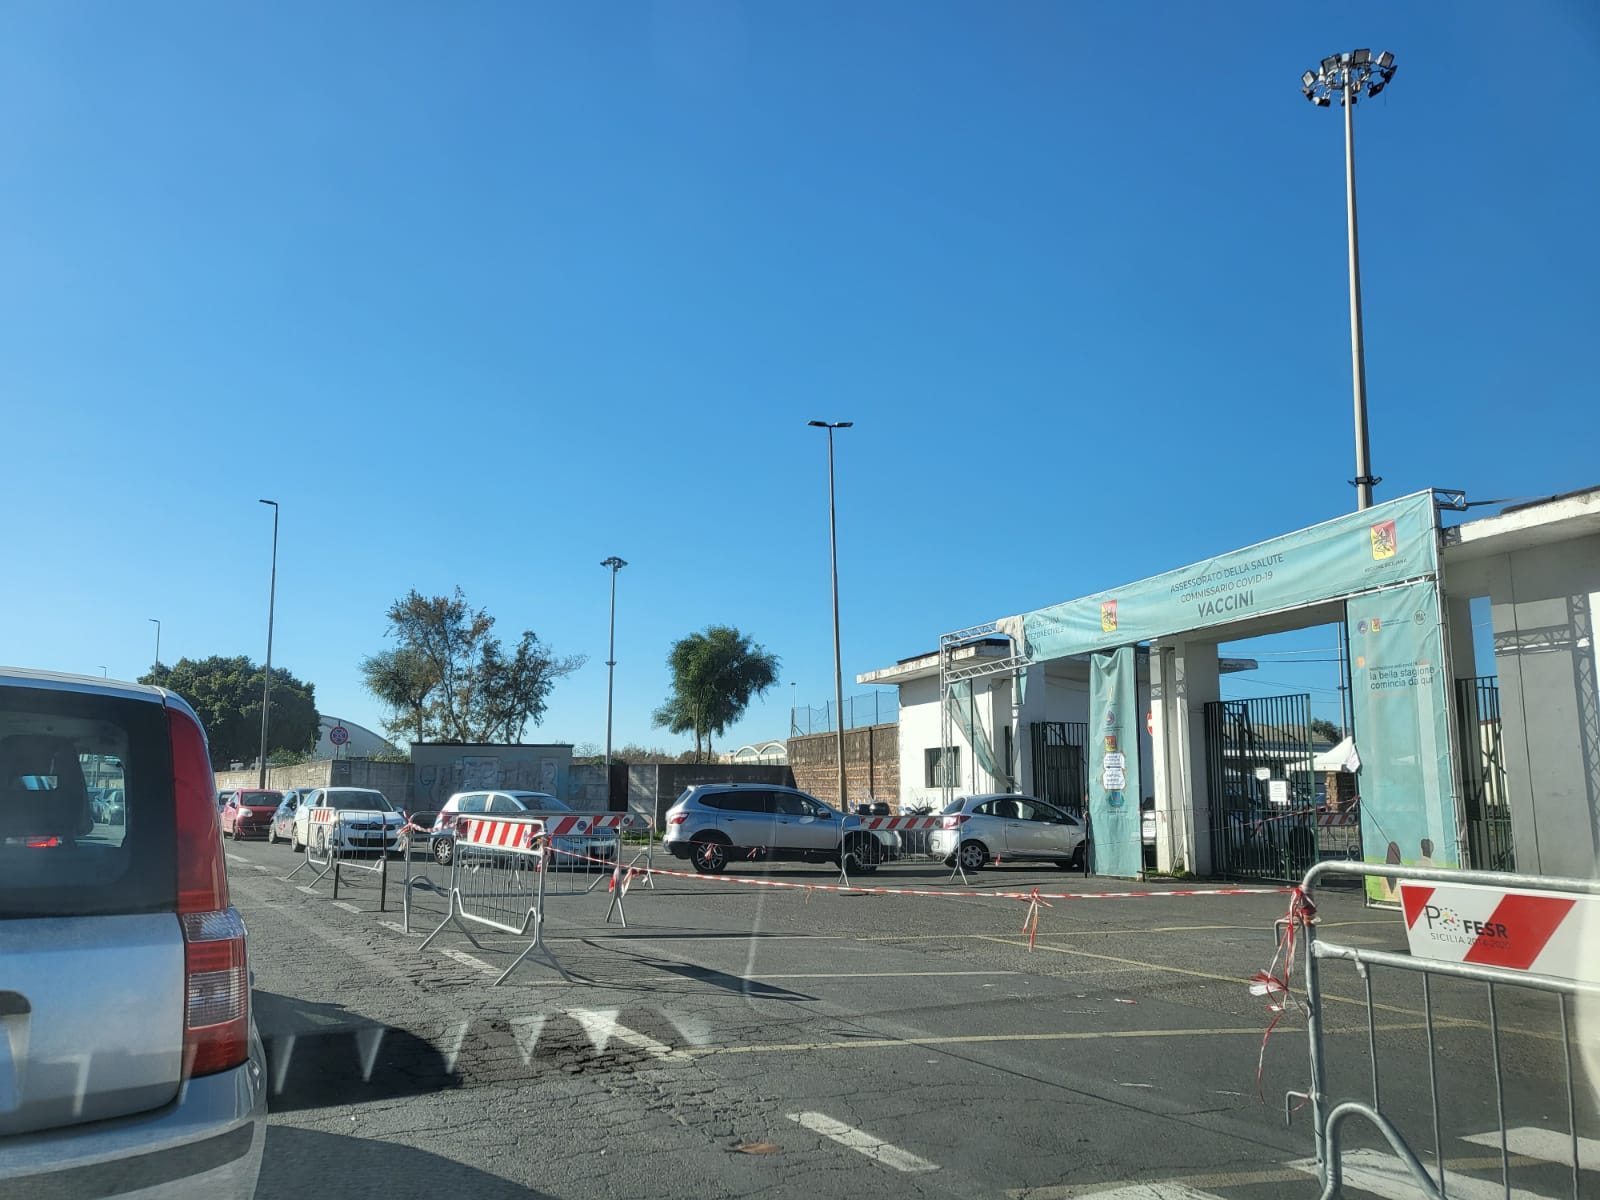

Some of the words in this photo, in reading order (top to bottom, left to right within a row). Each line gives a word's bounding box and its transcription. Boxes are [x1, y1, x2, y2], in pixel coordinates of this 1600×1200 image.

[1170, 571, 1221, 593] ASSESSORATO
[1223, 563, 1250, 579] DELLA
[1251, 553, 1284, 571] SALUTE
[1180, 581, 1234, 603] COMMISSARIO
[1236, 570, 1273, 588] COVID-19
[1197, 589, 1254, 618] VACCINI
[1369, 671, 1377, 681] la
[1379, 669, 1398, 680] bella
[1400, 666, 1435, 678] stagione
[1370, 678, 1406, 690] comincia
[1408, 677, 1418, 686] da
[1420, 674, 1434, 686] qui
[1463, 919, 1508, 938] FESR
[1430, 932, 1465, 945] SICILIA
